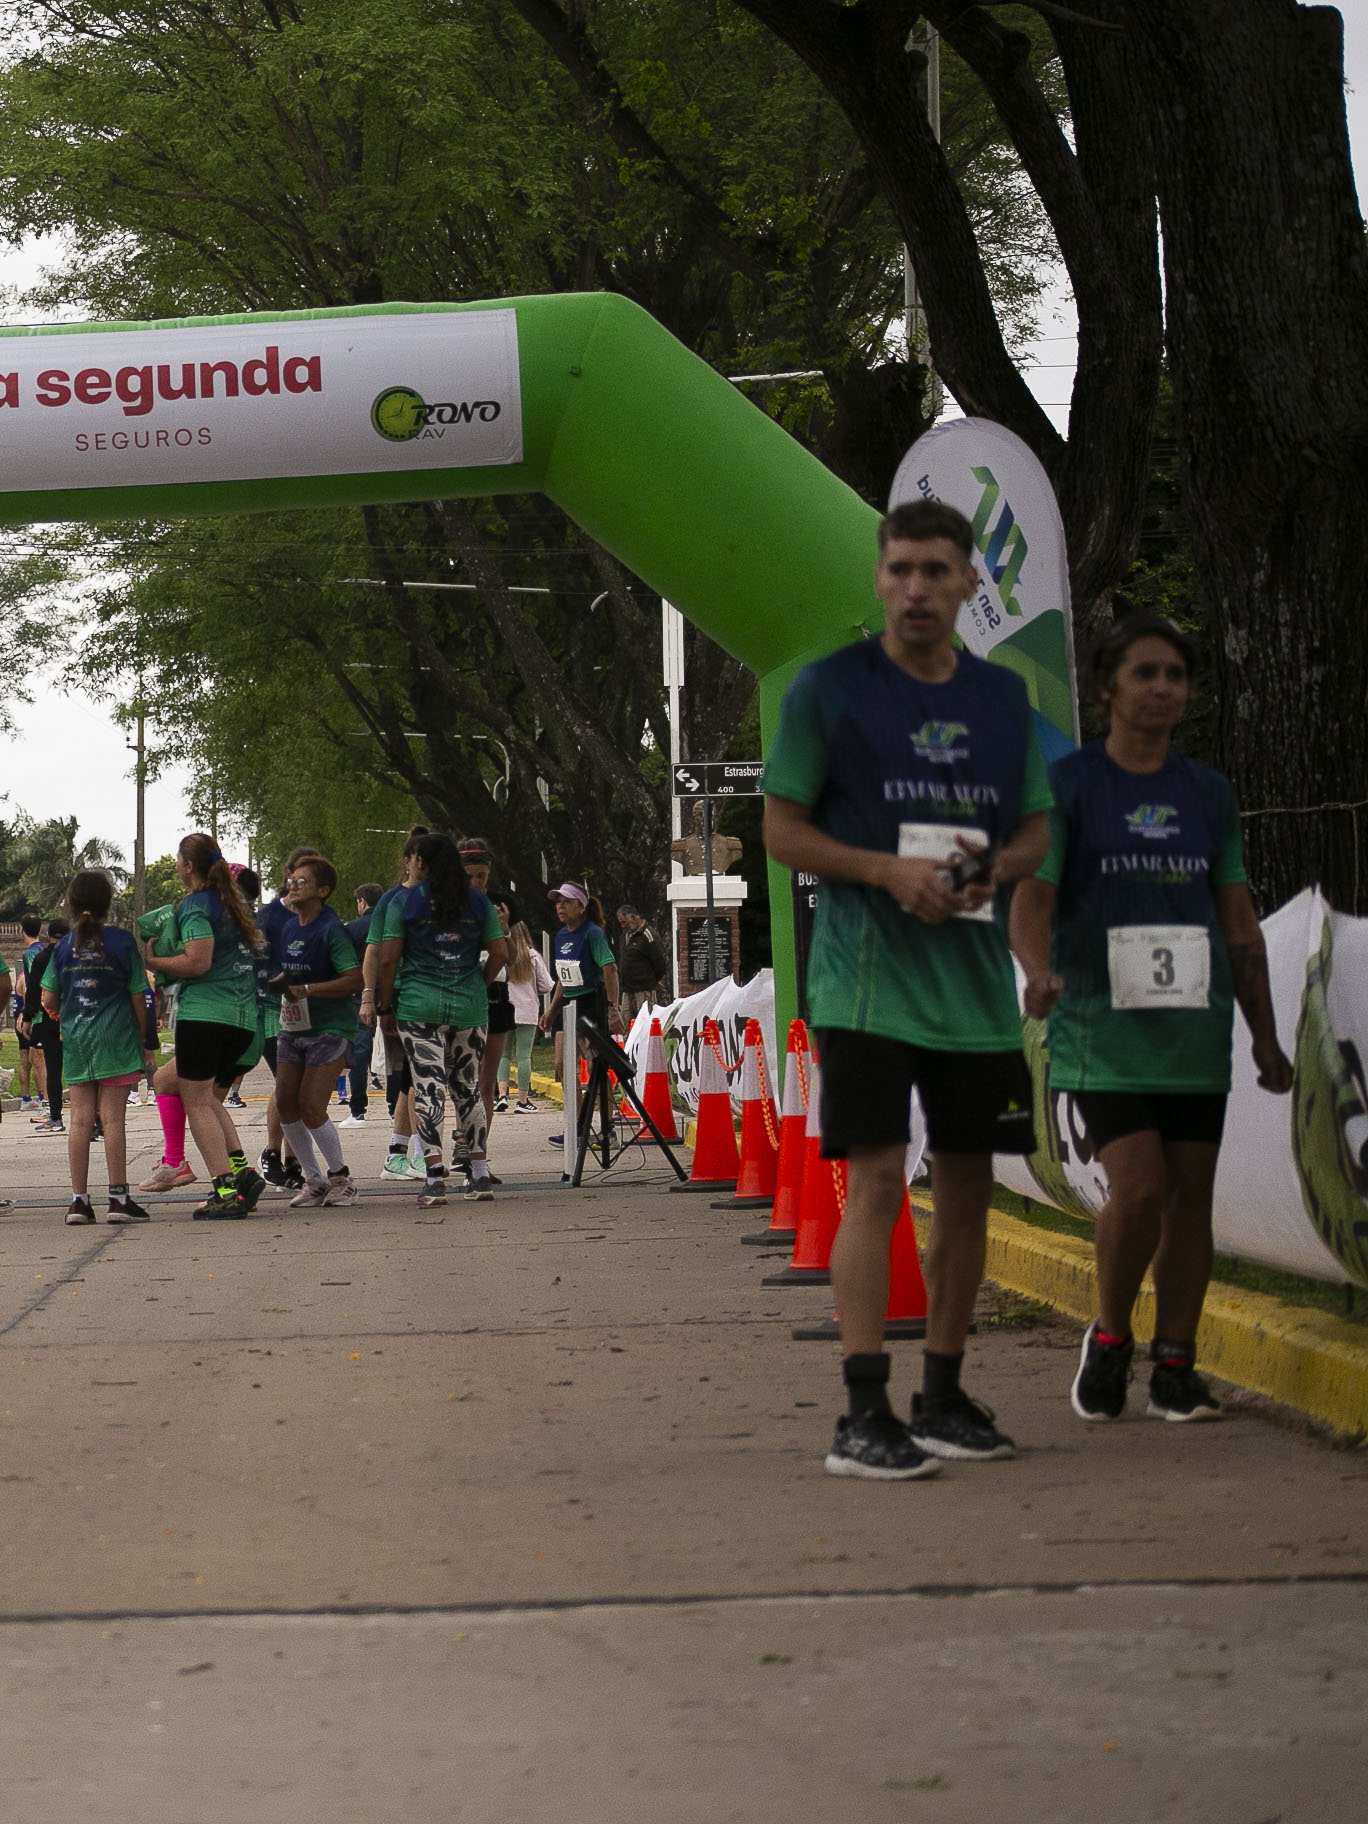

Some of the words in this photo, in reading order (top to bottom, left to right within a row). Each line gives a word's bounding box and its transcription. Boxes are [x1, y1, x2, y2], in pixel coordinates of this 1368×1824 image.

[34, 346, 323, 417] segunda
[74, 427, 213, 453] SEGUROS
[560, 967, 572, 980] 61
[1151, 948, 1175, 986] 3
